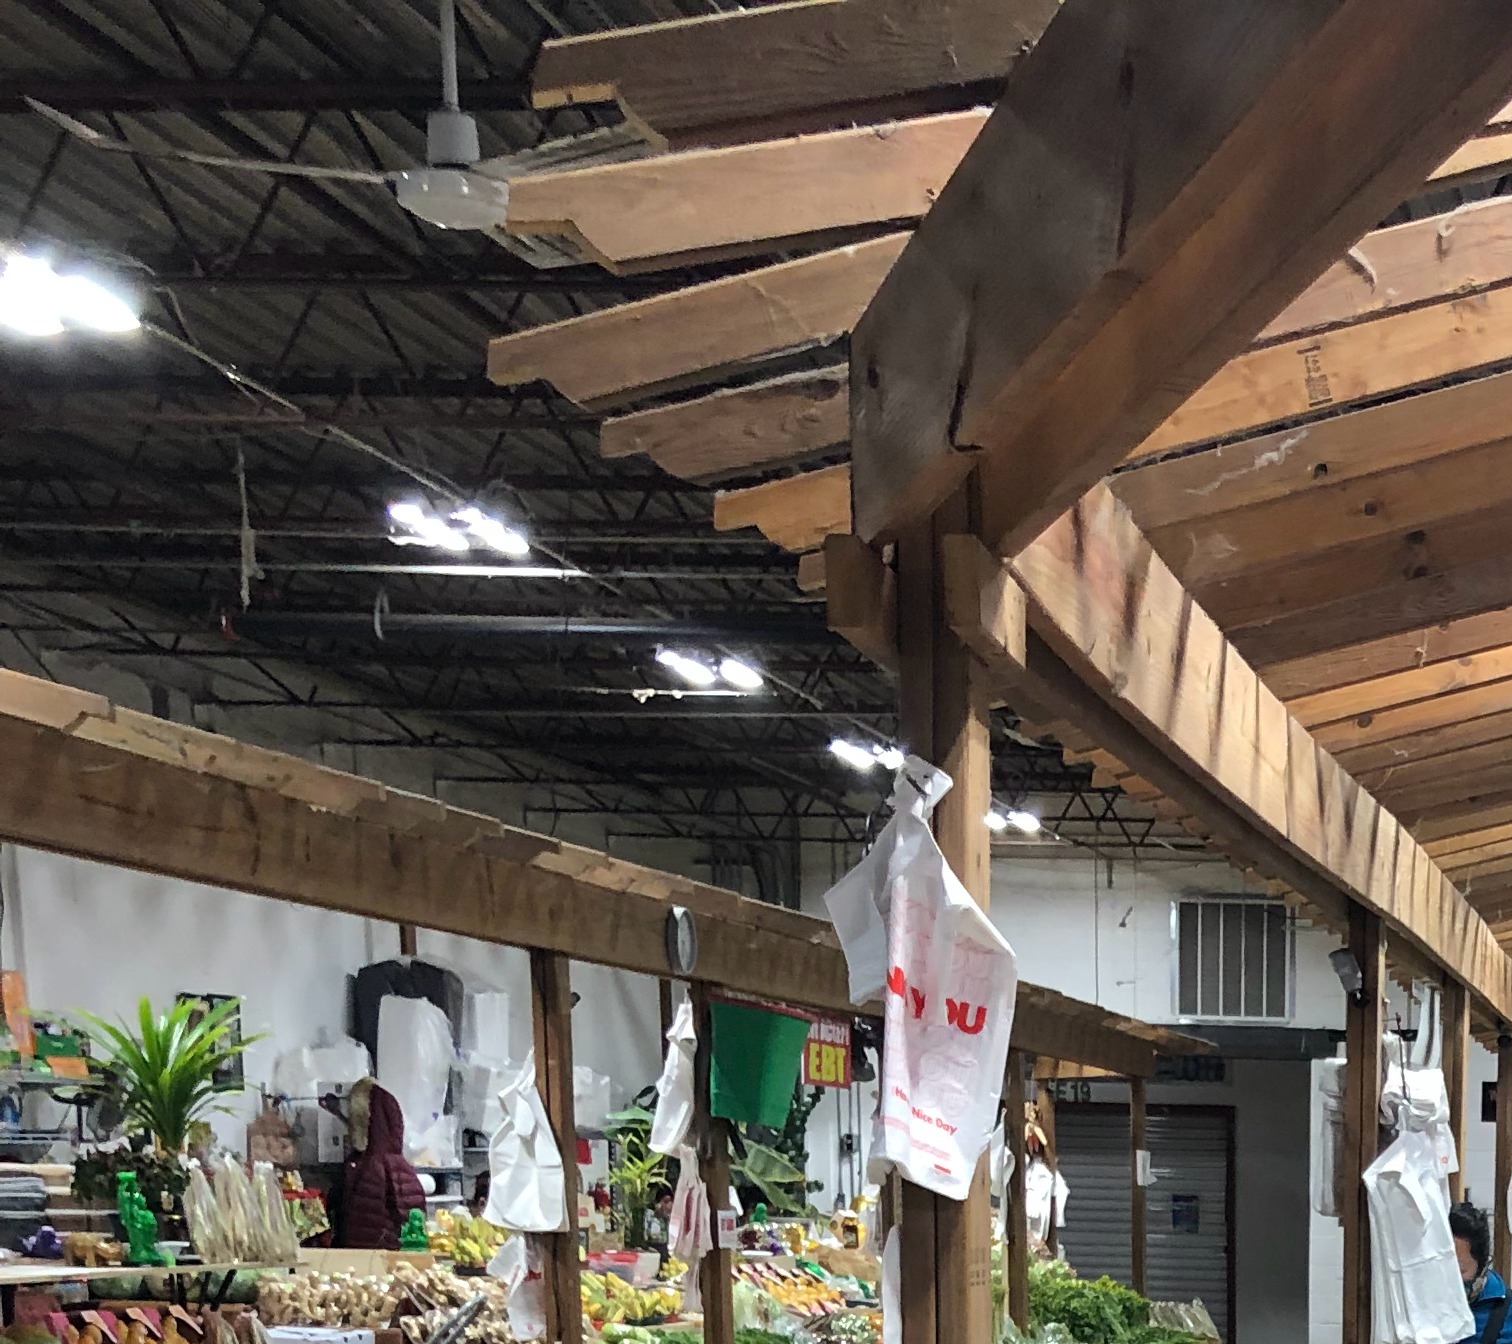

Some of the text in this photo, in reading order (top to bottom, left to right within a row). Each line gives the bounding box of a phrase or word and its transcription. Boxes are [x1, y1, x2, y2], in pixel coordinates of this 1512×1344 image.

[808, 1041, 847, 1085] EBT
[911, 1106, 958, 1136] Nice Day
